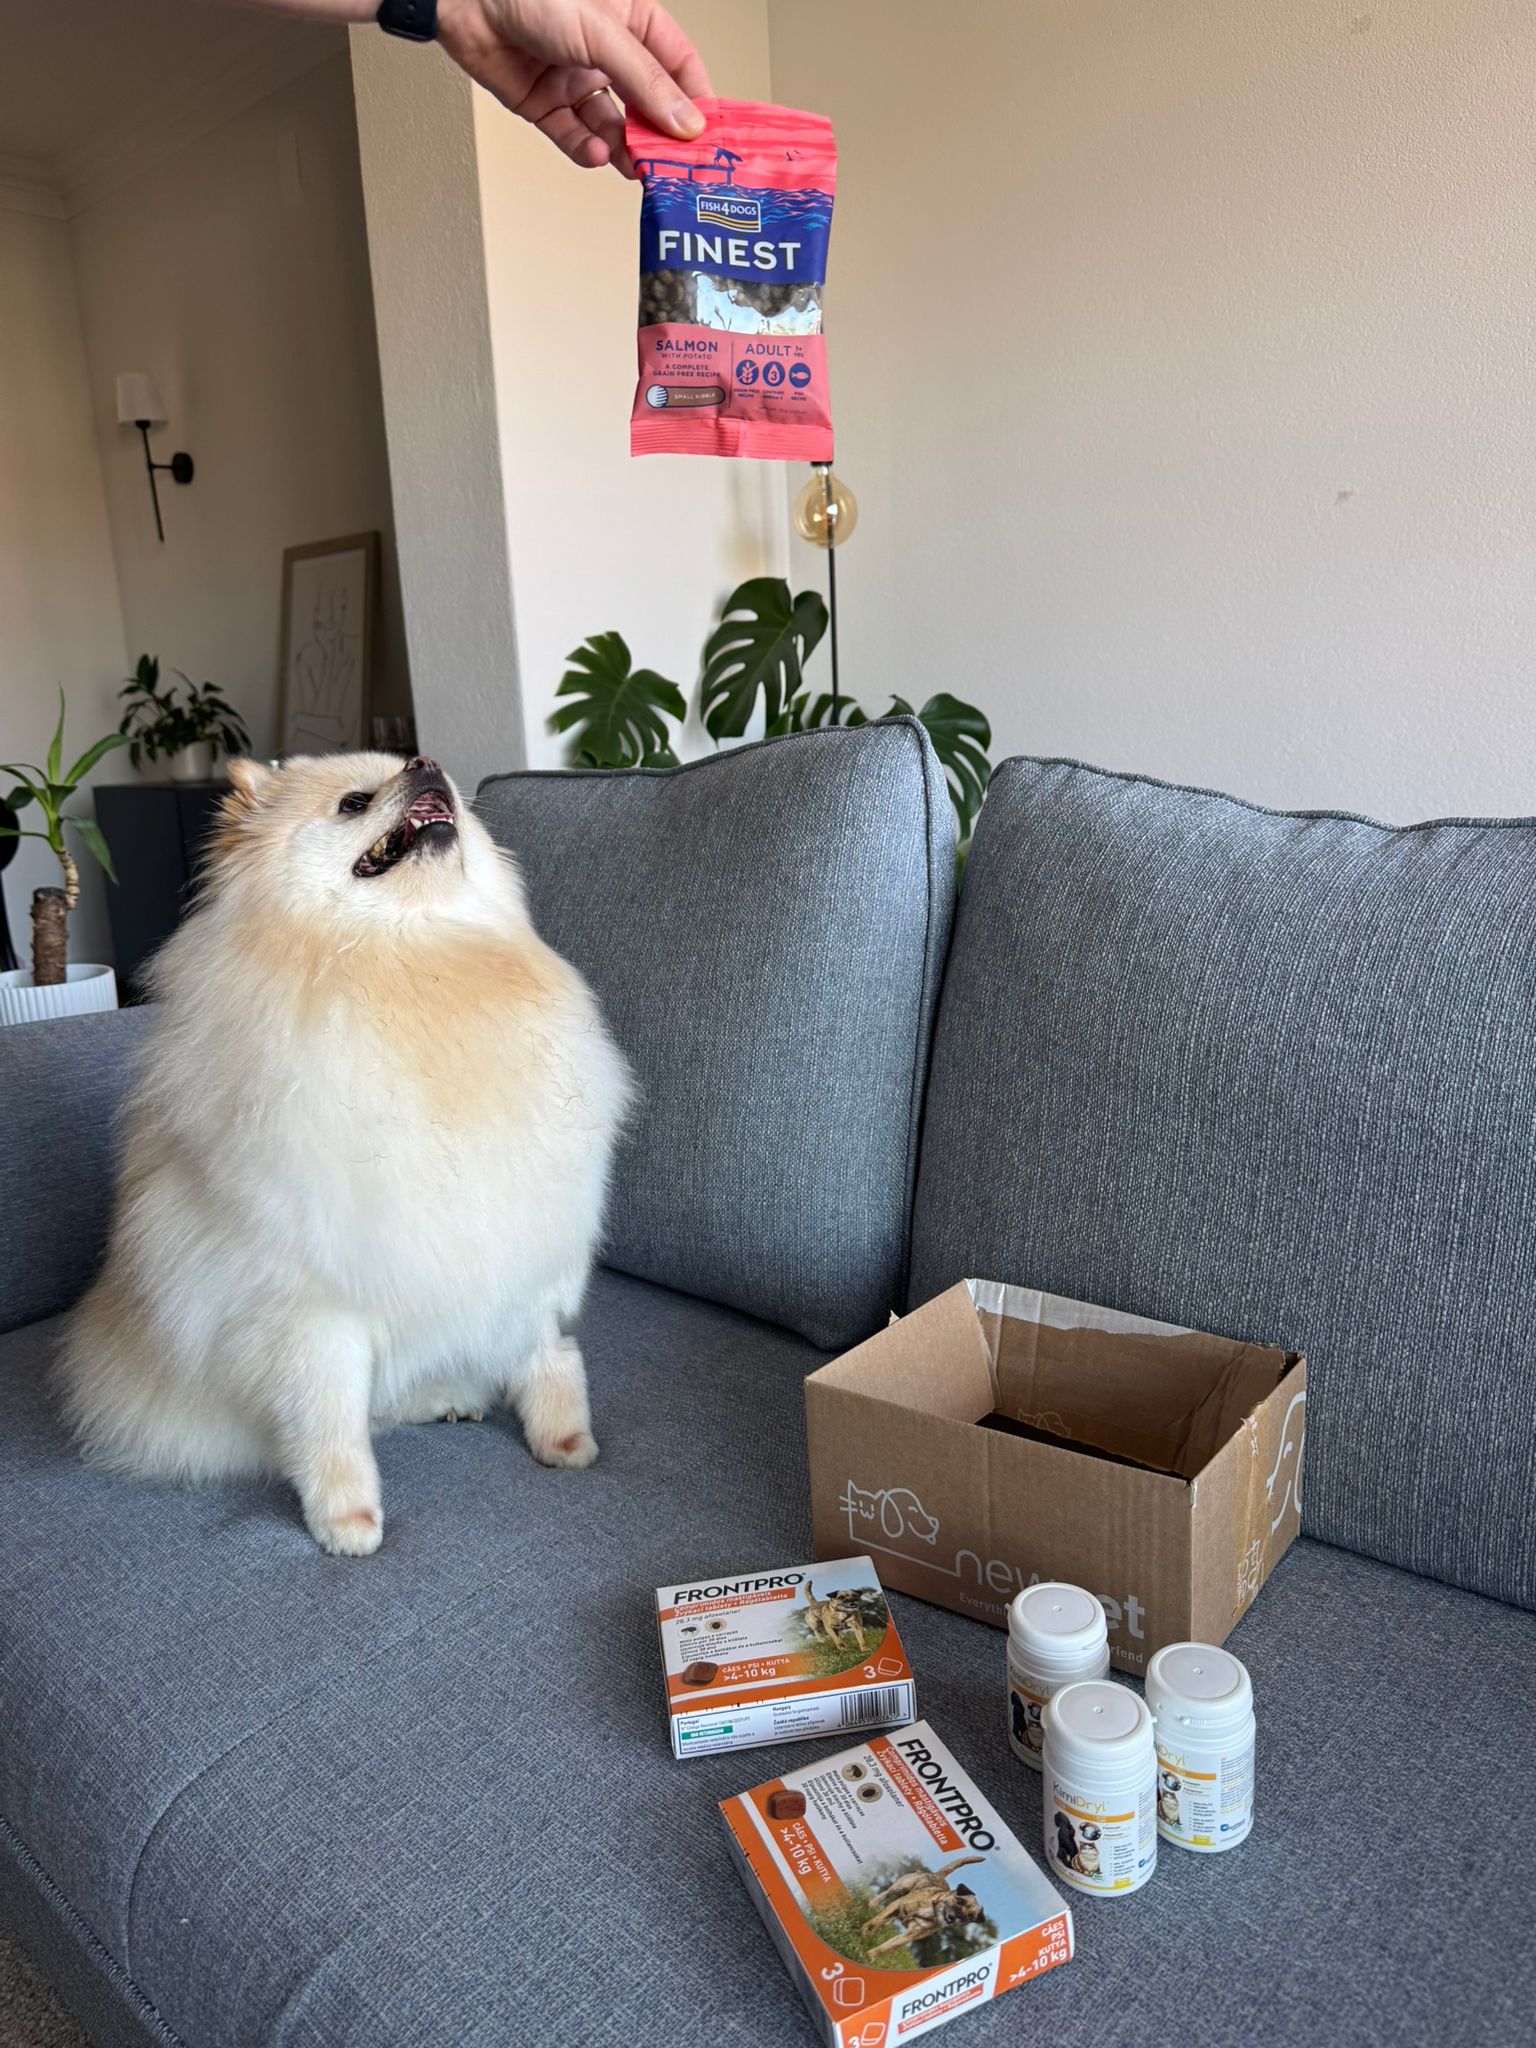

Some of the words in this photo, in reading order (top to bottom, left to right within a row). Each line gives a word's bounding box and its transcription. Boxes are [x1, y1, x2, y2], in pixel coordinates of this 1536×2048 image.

[700, 200, 757, 216] FISH4DOGS
[658, 230, 801, 271] FINEST
[656, 340, 718, 352] SALMON
[745, 343, 791, 357] ADULT
[770, 371, 778, 381] 3
[671, 1572, 805, 1604] FRONTPRO
[1109, 1644, 1144, 1664] riend
[721, 1664, 741, 1673] CÃES
[765, 1657, 790, 1666] KUTYA
[760, 1665, 776, 1676] kg
[863, 1665, 876, 1679] 3
[884, 1745, 920, 1788] Comprimidos
[896, 1735, 1000, 1855] FRONTPRO
[1053, 1781, 1105, 1813] KimiDryl
[791, 1820, 809, 1840] CÃES
[803, 1842, 816, 1855] PSI
[812, 1858, 832, 1883] KUTYA
[793, 1857, 814, 1875] kg
[1041, 1917, 1063, 1938] CÃES
[1051, 1928, 1064, 1942] PSI
[1038, 1936, 1066, 1957] KUTYA
[1050, 1944, 1067, 1965] kg
[818, 1960, 847, 1982] 3
[901, 1963, 990, 2019] FRONTPRO
